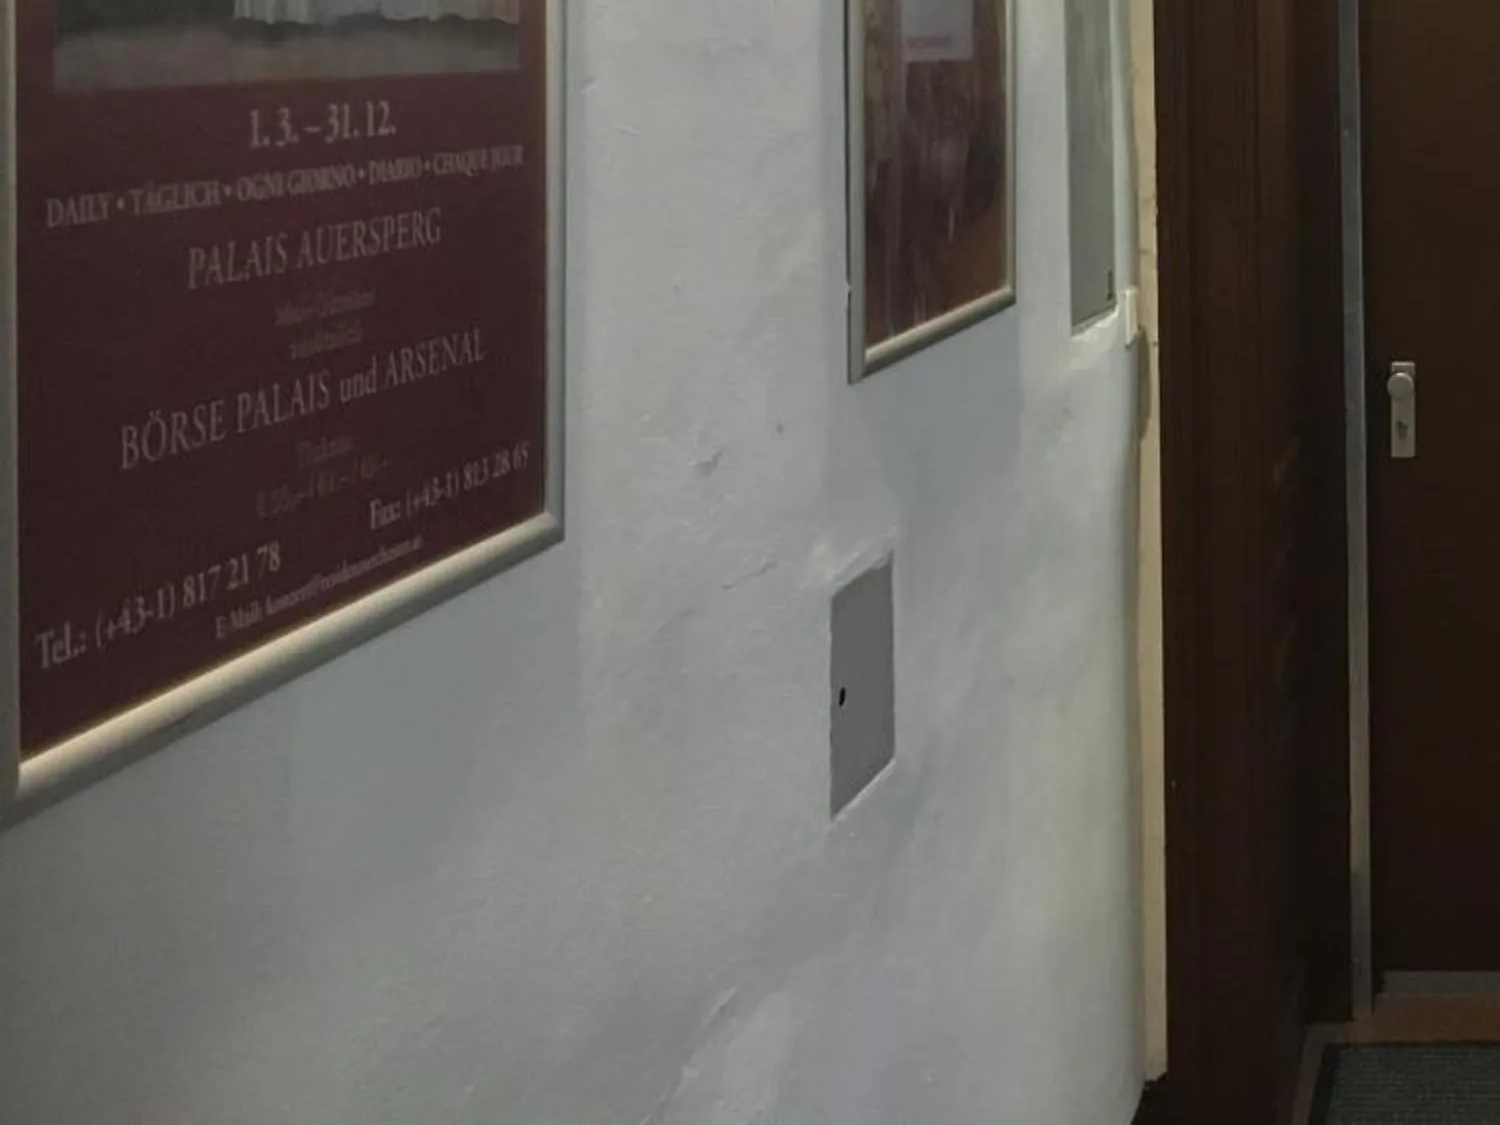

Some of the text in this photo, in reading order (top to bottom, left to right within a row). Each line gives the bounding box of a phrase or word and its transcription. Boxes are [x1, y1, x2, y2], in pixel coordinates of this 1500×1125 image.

[46, 191, 112, 228] DAILY
[128, 179, 222, 216] TÄGLICH
[187, 207, 442, 289] PALAIS AUERSPERG
[119, 402, 227, 471] BÖRSE
[236, 368, 331, 434] PALAIS
[340, 355, 377, 403] und
[383, 327, 487, 389] ARSENAL
[183, 565, 221, 608] 817
[227, 552, 249, 590] 21
[257, 539, 281, 580] 78
